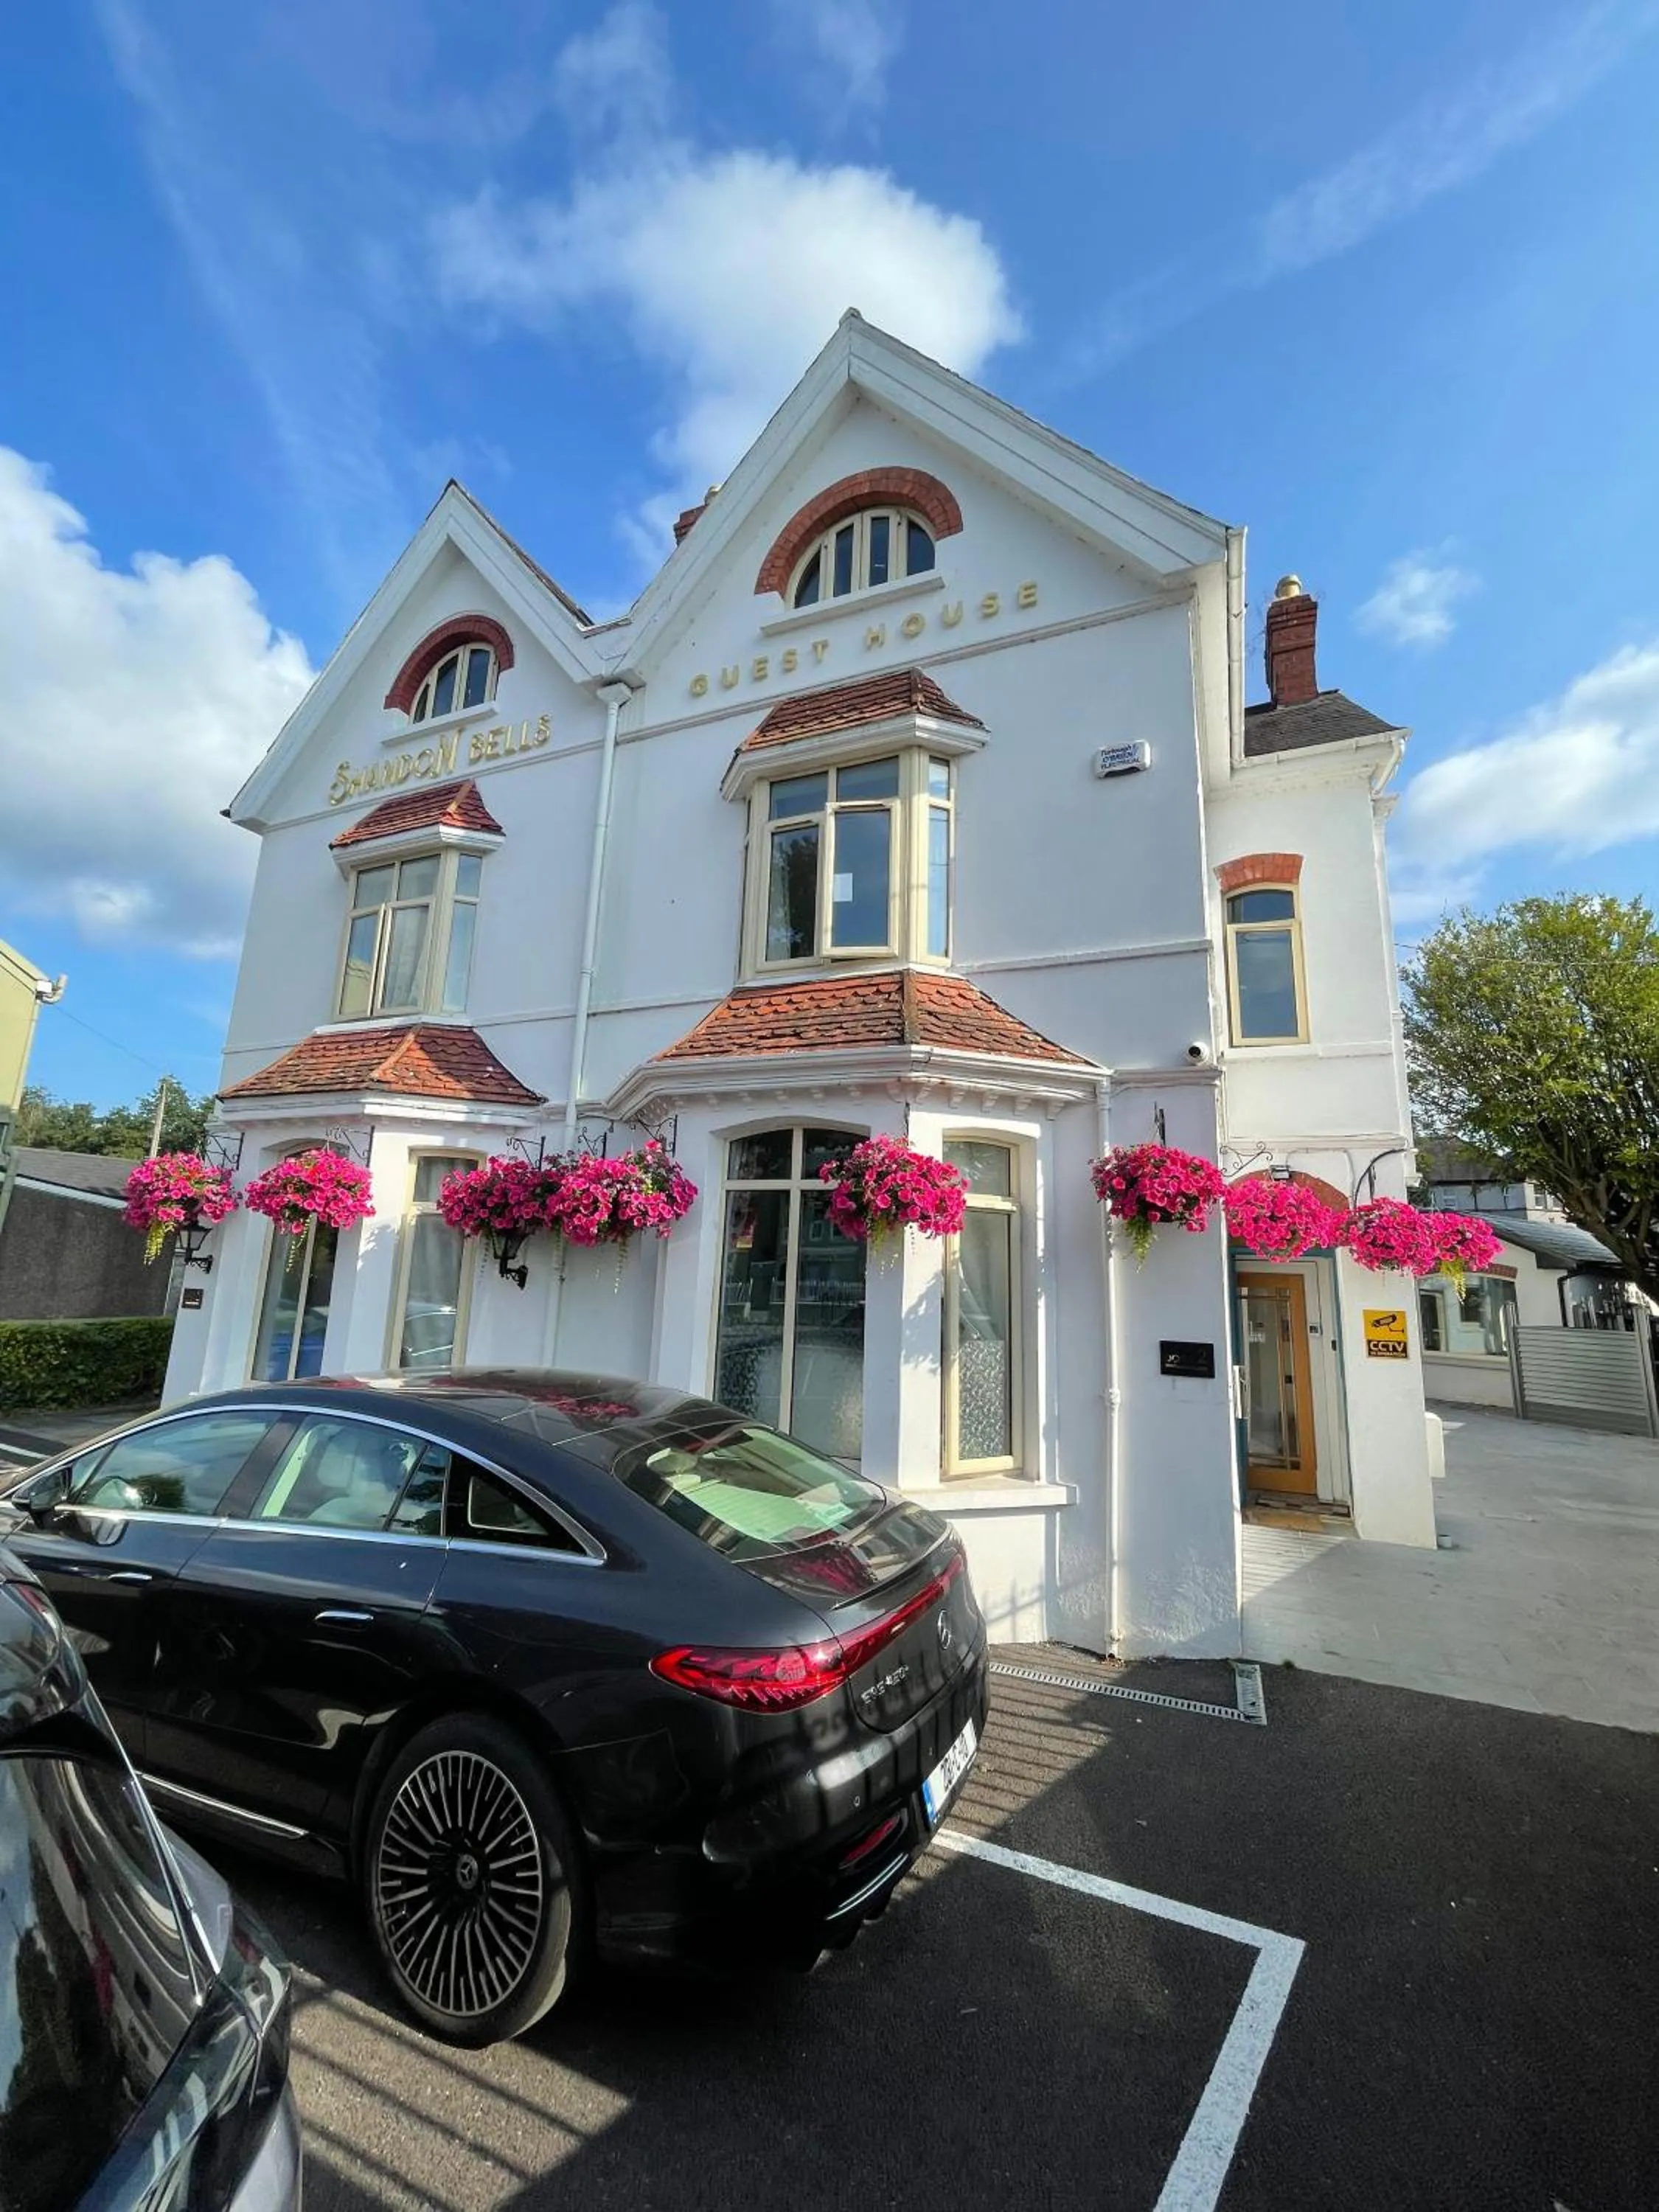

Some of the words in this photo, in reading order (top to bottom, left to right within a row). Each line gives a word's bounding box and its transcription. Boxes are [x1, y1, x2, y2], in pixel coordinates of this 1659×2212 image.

[690, 639, 829, 697] GUEST
[866, 581, 1038, 651] HOUSE
[329, 728, 462, 806] SHANDON
[469, 714, 552, 765] BELLS
[1369, 1341, 1405, 1352] CCTV
